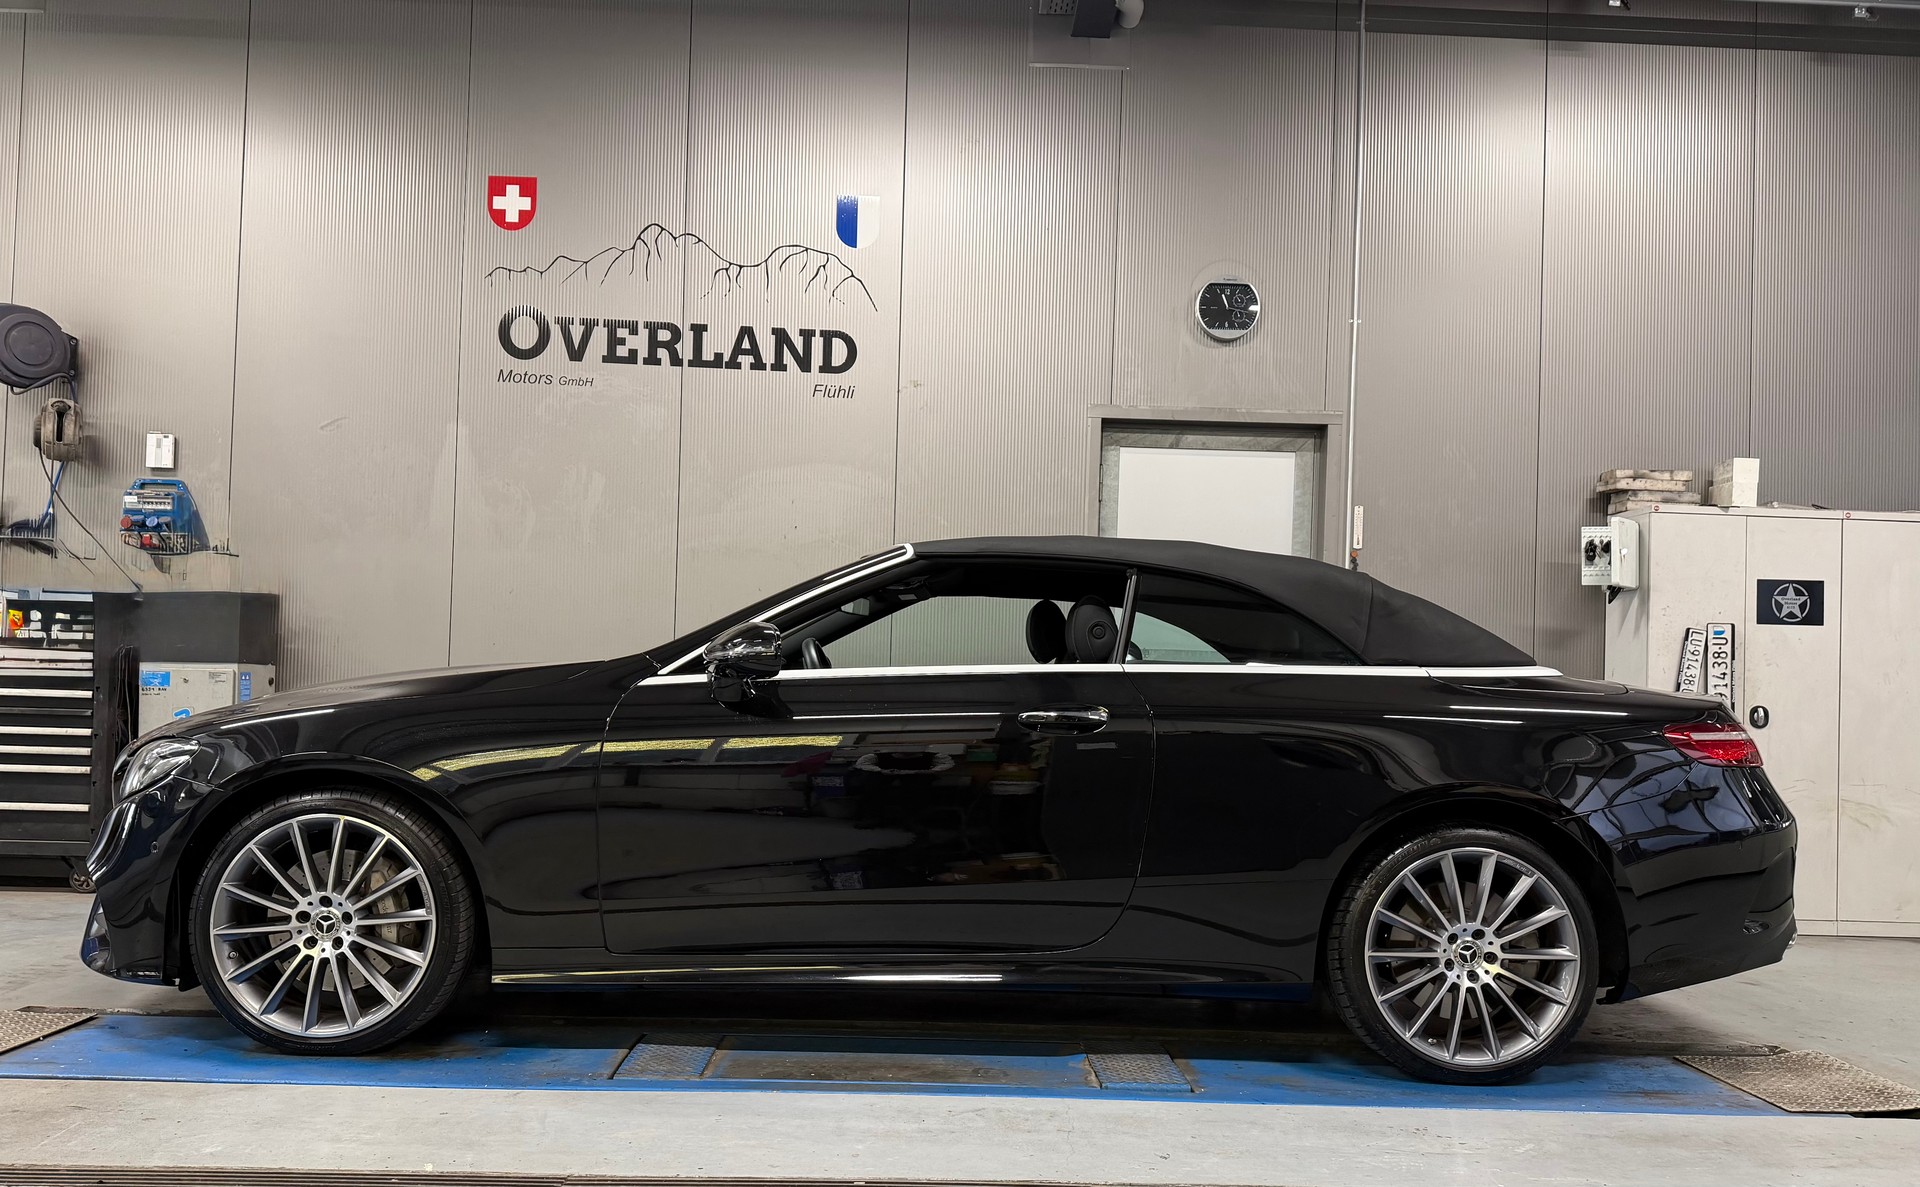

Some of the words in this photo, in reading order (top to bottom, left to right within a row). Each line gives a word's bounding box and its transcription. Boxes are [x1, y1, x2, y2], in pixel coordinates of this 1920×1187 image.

[498, 304, 858, 374] OVERLAND
[497, 368, 553, 385] Motors
[558, 375, 594, 387] GmbH
[812, 384, 856, 399] Flühli
